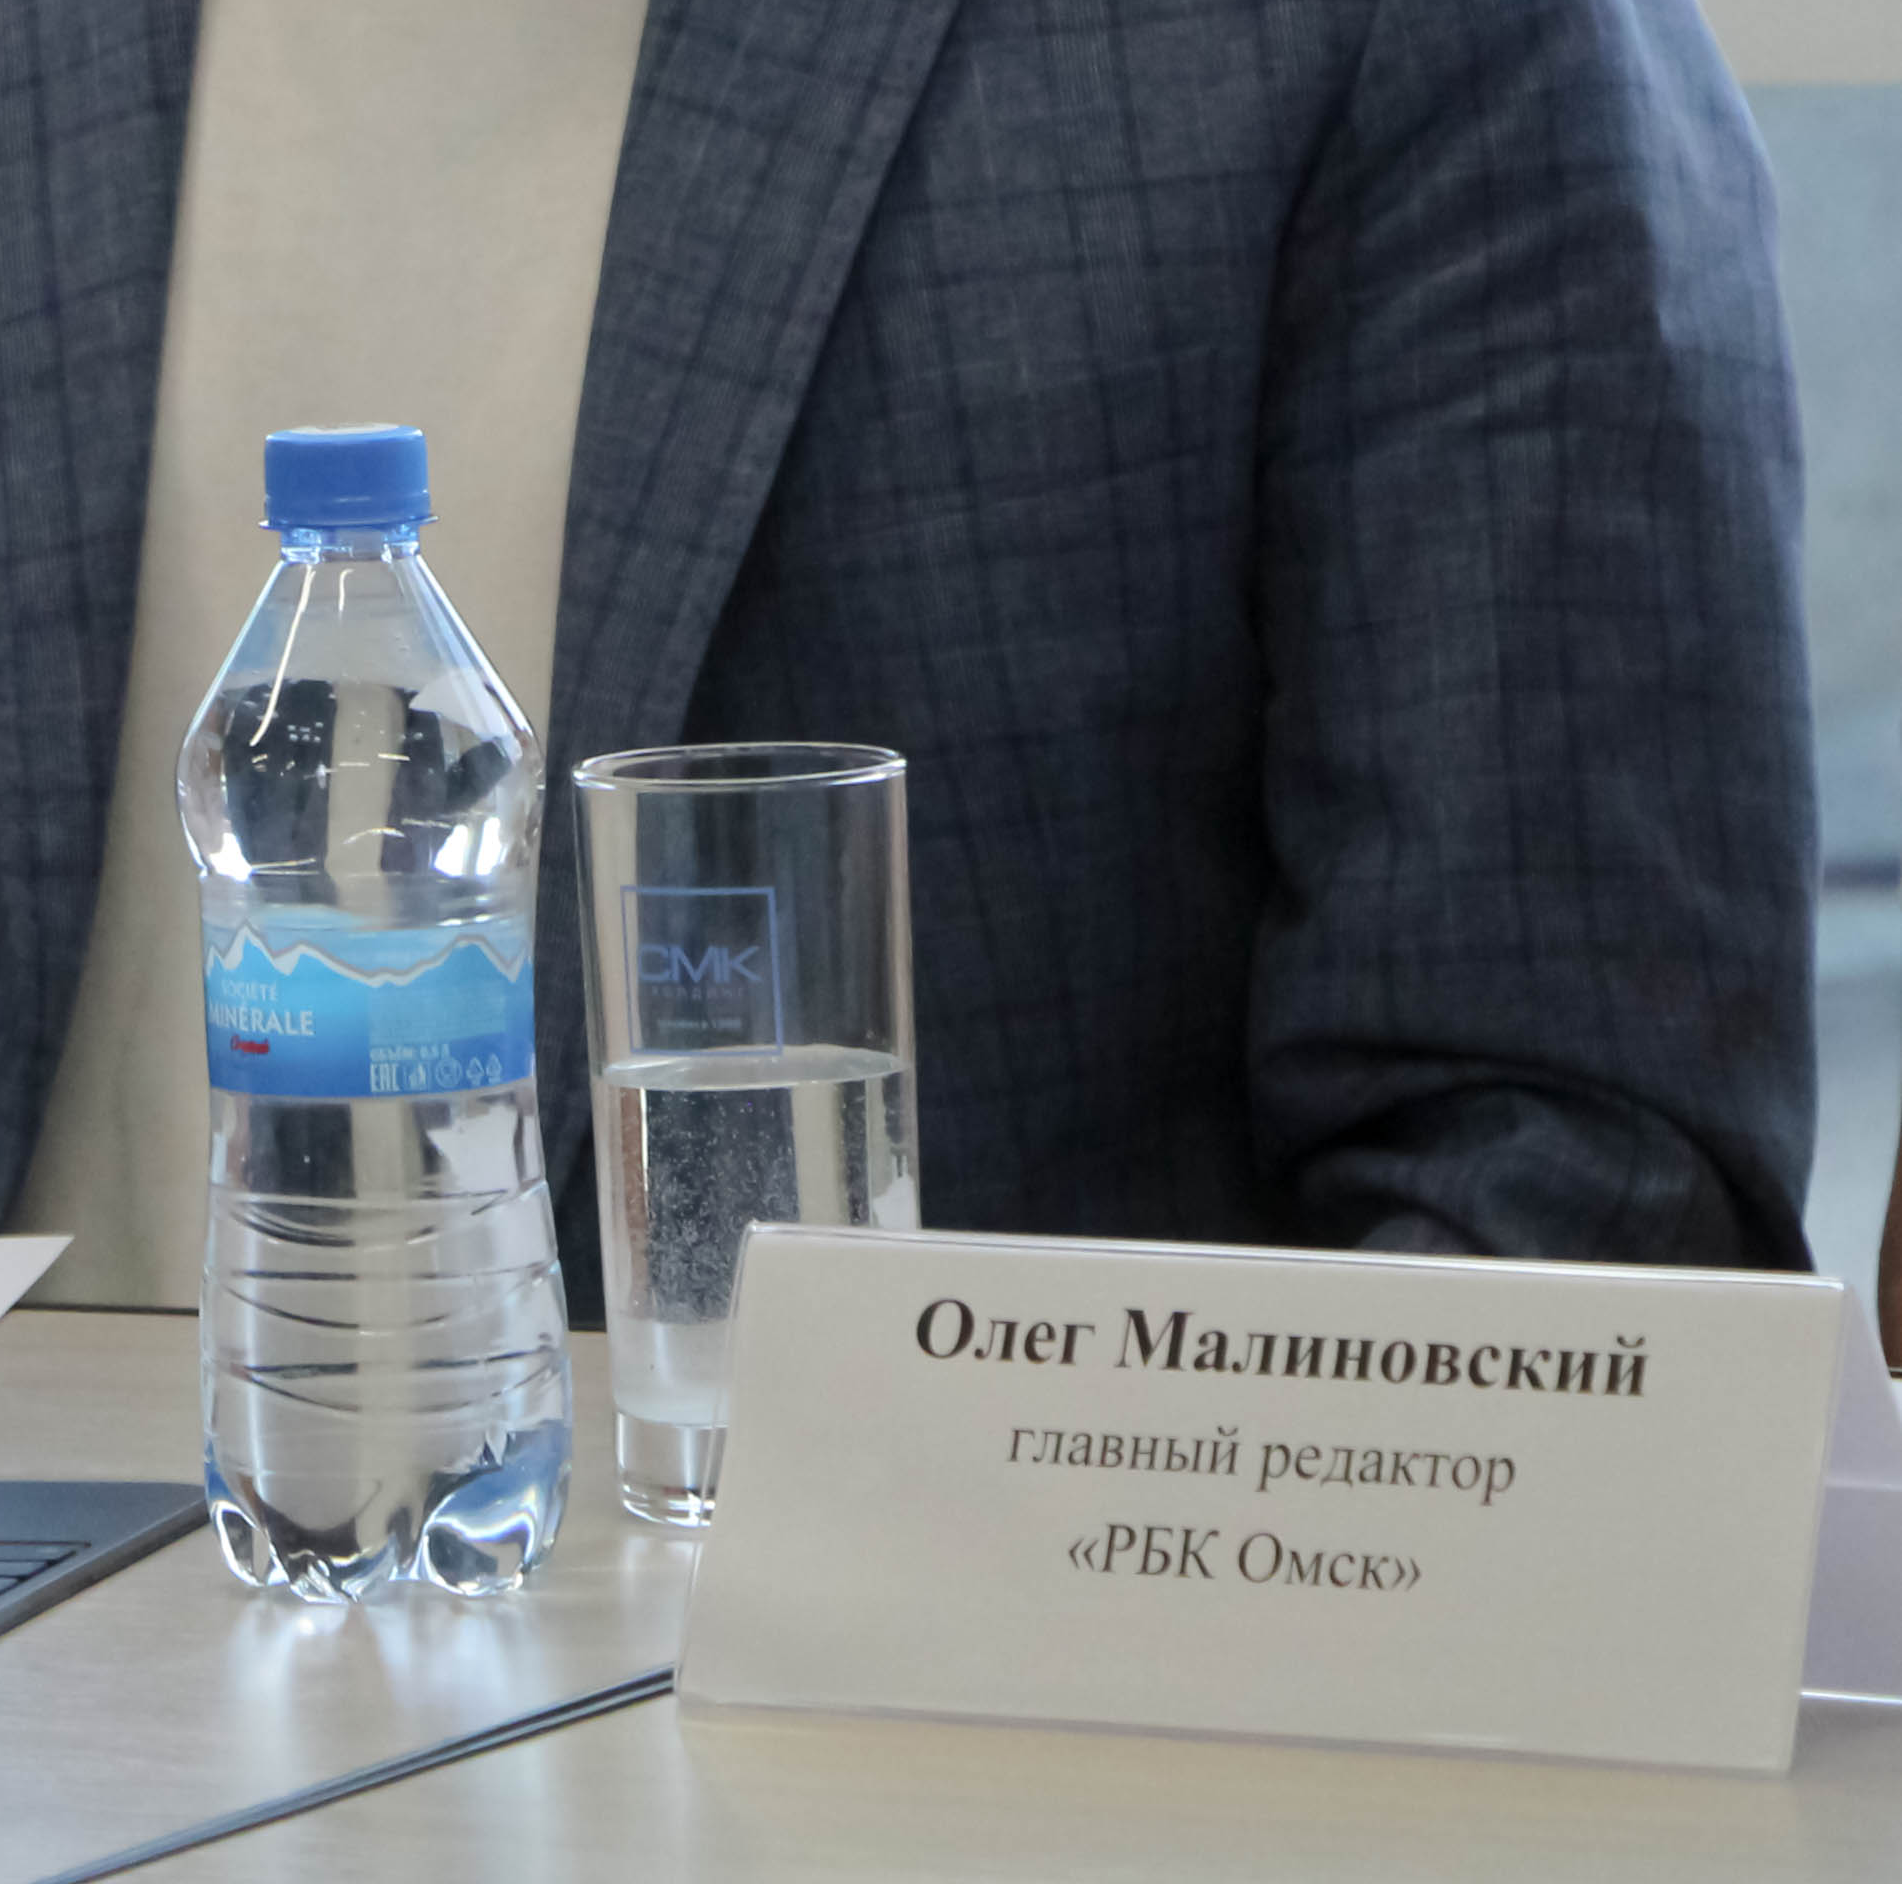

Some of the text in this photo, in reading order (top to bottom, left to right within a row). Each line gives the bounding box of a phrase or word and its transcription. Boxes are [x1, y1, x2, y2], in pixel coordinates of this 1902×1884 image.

[914, 1297, 1651, 1398] Олег Малиновский
[1007, 1423, 1517, 1504] главный редактор
[1066, 1522, 1423, 1592] «РБК Омск»
